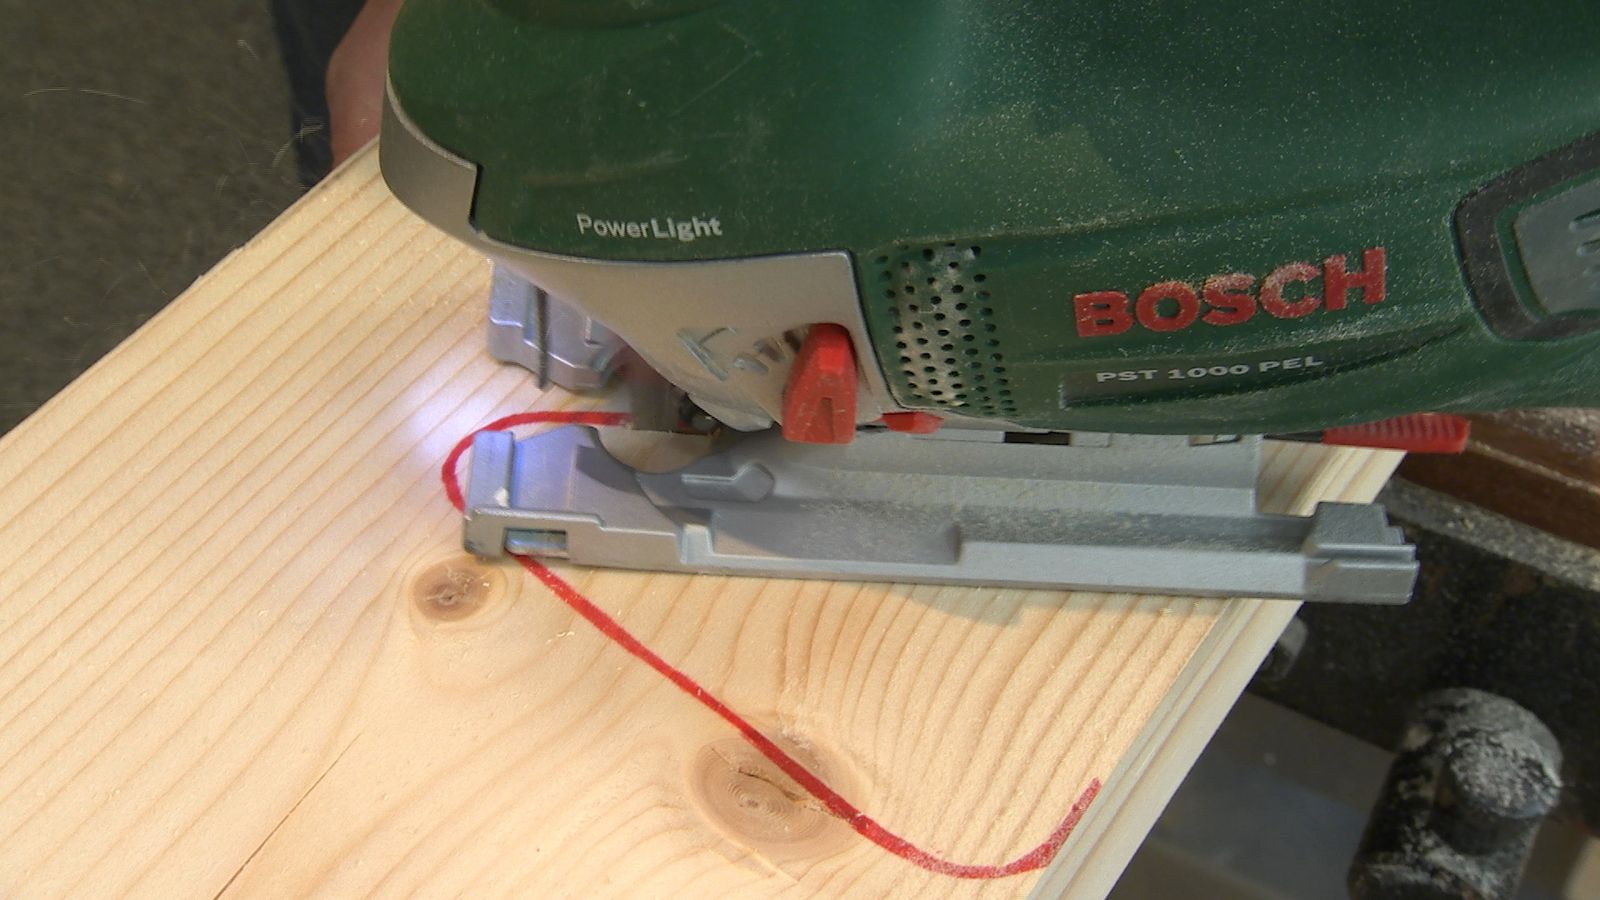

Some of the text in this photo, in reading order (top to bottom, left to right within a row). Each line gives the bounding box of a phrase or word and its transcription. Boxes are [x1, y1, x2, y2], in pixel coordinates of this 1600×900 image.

[577, 212, 723, 241] PowerLight
[1073, 247, 1387, 337] BOSCH
[1096, 356, 1324, 383] PST 1000 PEL
